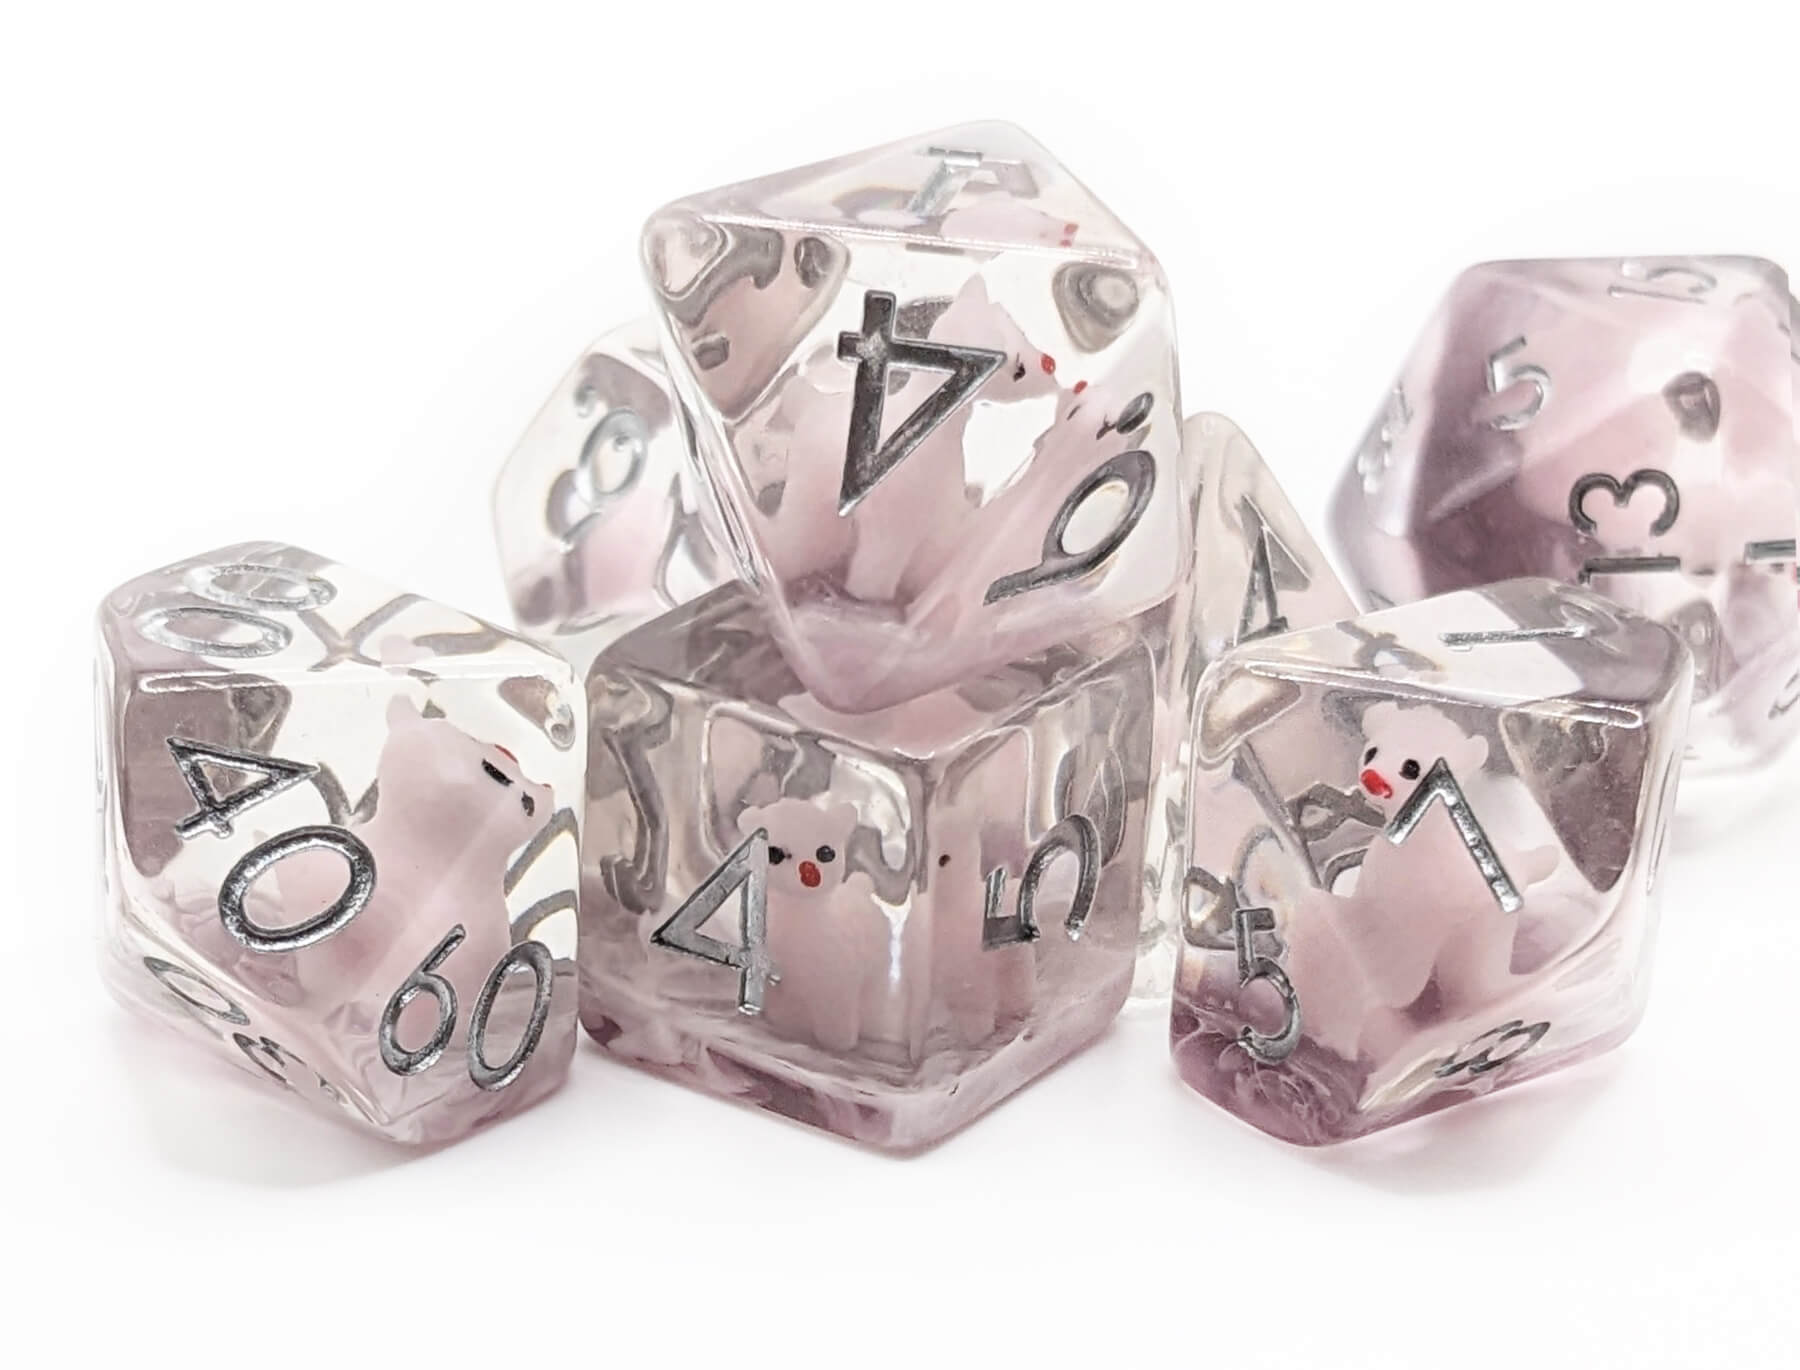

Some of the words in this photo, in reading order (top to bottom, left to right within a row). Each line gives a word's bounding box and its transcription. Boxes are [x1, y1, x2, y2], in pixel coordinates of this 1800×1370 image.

[838, 290, 1007, 517] 4
[1486, 336, 1551, 430] 5
[1567, 468, 1681, 586] 13
[137, 563, 338, 659] 00
[166, 735, 378, 953] 40
[983, 814, 1096, 951] 5
[1385, 756, 1524, 914] 7
[651, 828, 782, 1015] 4
[1233, 907, 1302, 1065] 5
[378, 923, 554, 1092] 60
